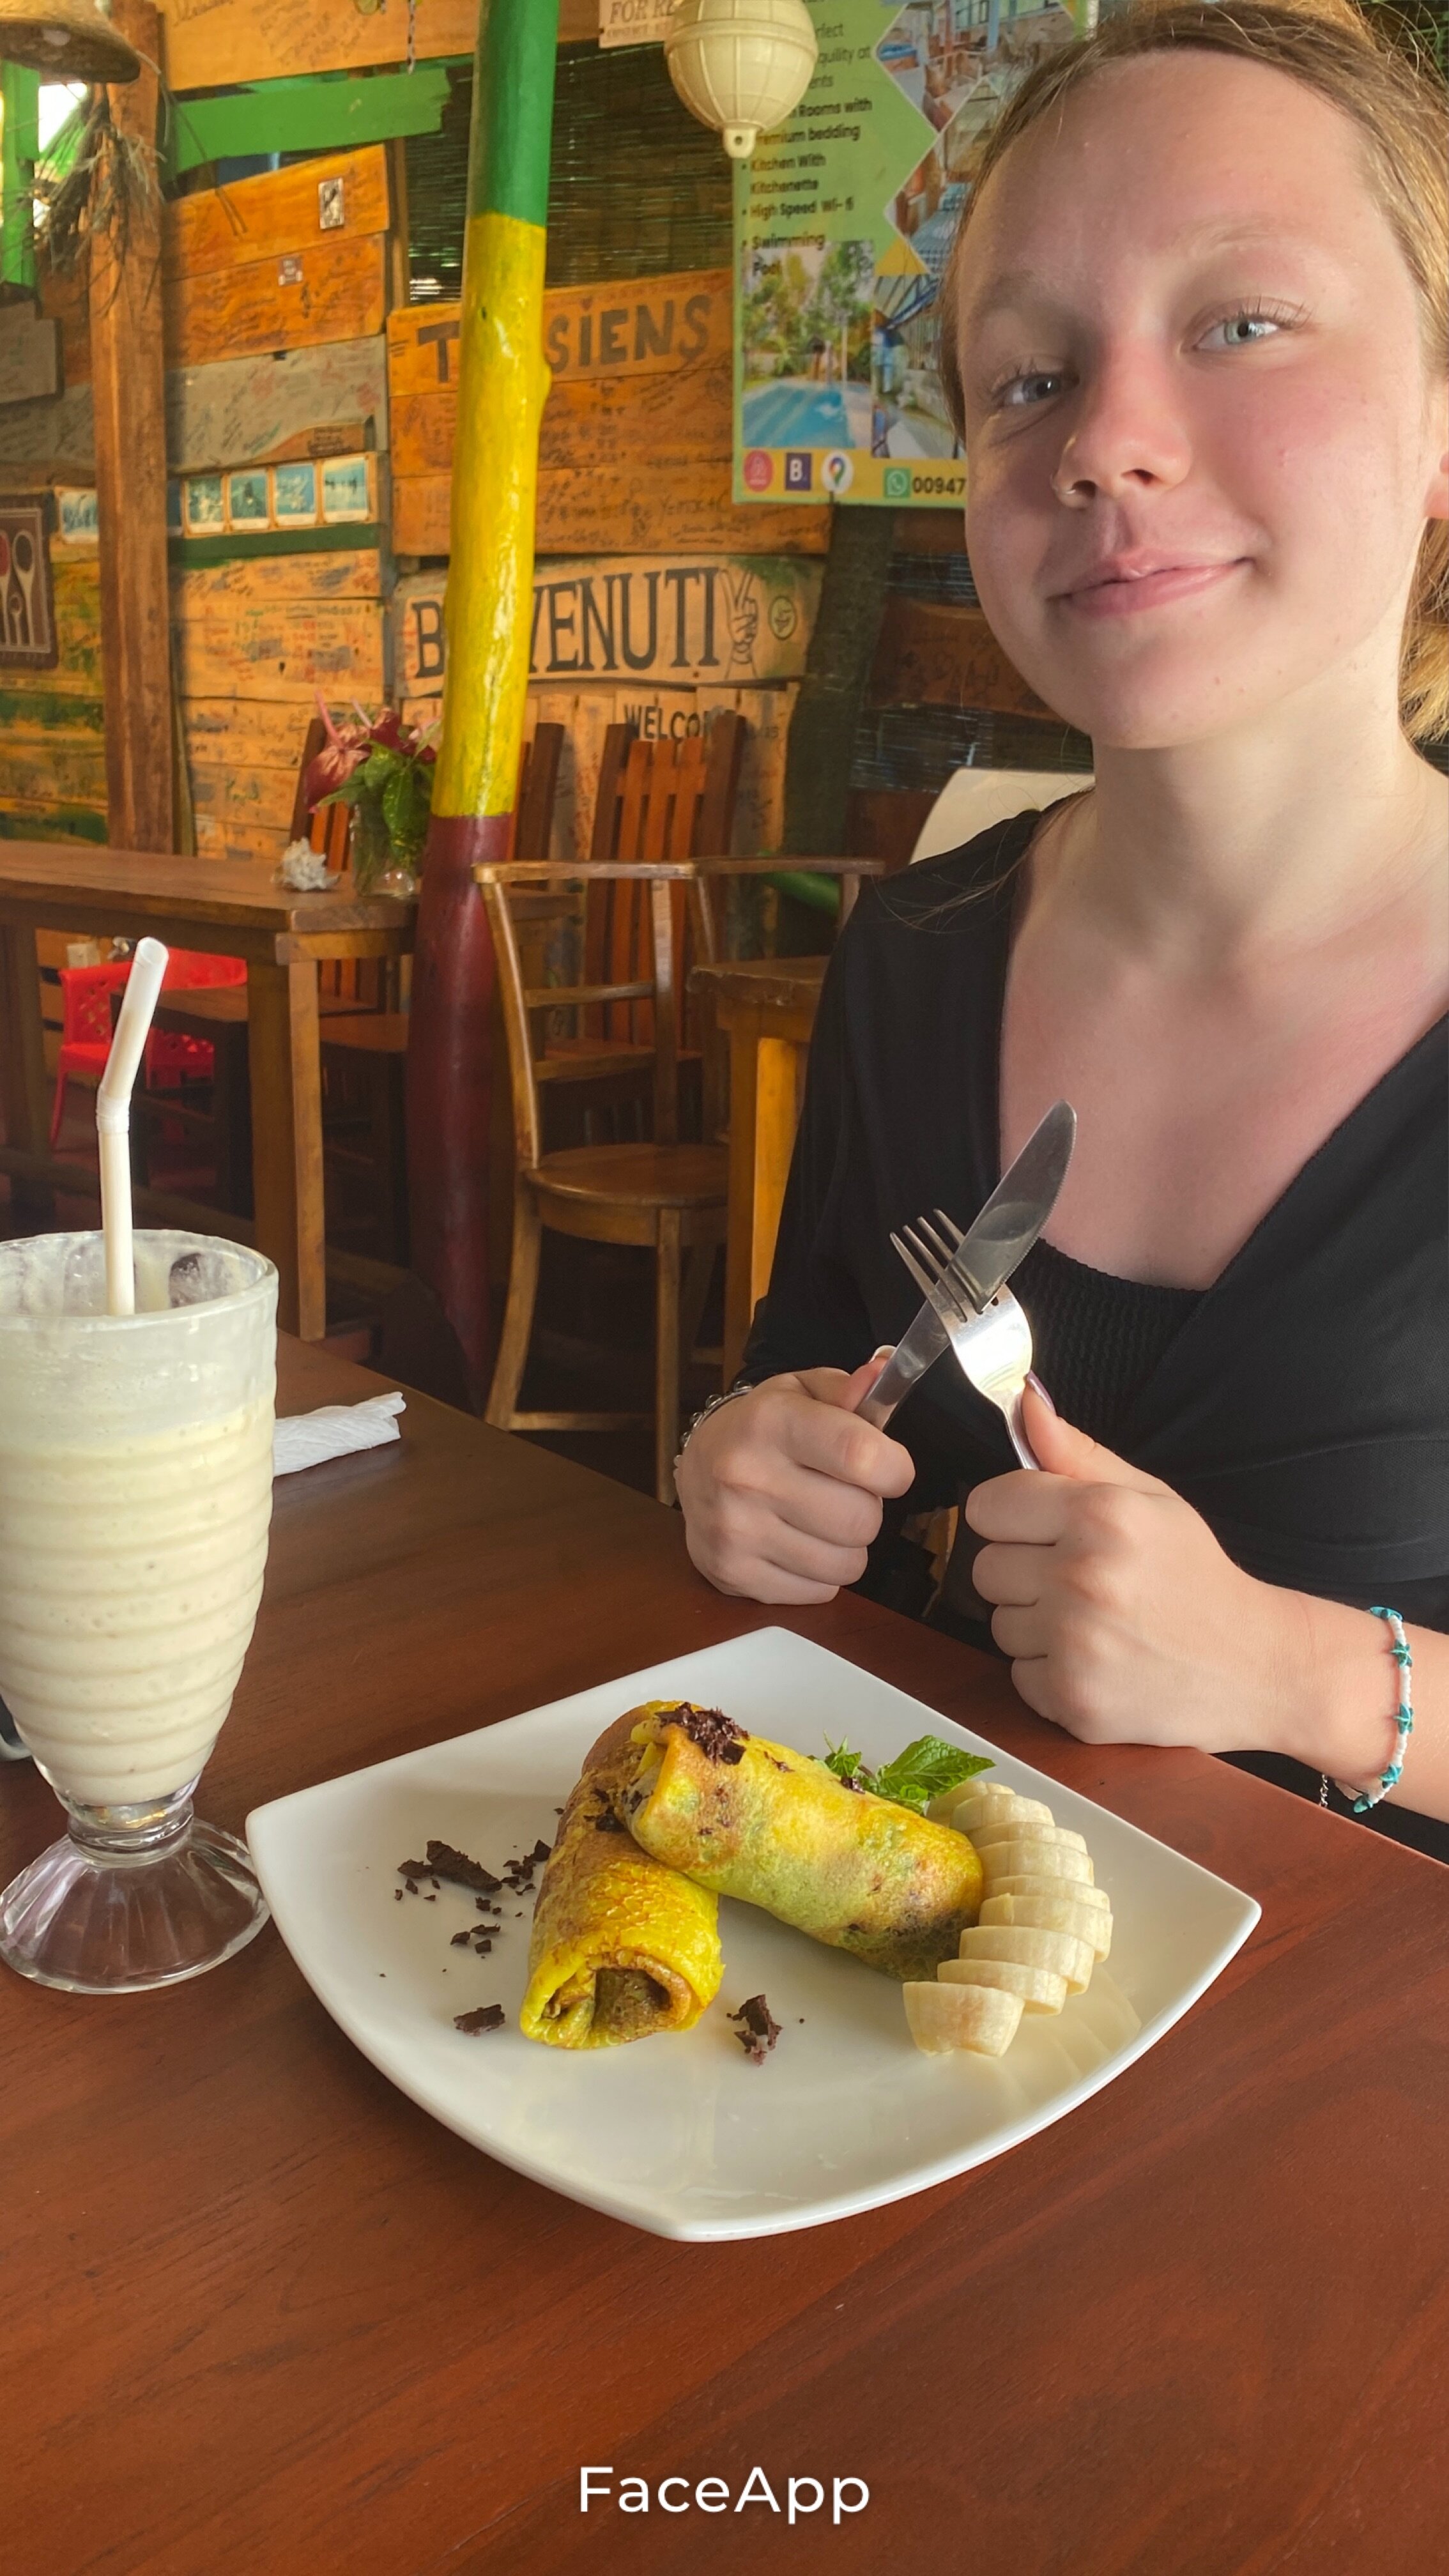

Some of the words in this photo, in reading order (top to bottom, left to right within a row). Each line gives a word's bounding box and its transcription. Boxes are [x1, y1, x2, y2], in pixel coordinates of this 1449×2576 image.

[610, 0, 647, 24] FOR
[815, 23, 843, 39] rfect
[799, 103, 841, 118] Rooms
[844, 97, 872, 113] with
[755, 130, 806, 146] remium
[808, 124, 861, 141] bedding
[751, 158, 796, 172] Kitchen
[750, 204, 776, 221] High
[779, 201, 818, 219] Speed
[752, 232, 825, 251] Swimming
[411, 566, 720, 679] BENUTI
[624, 704, 710, 741] WELCO
